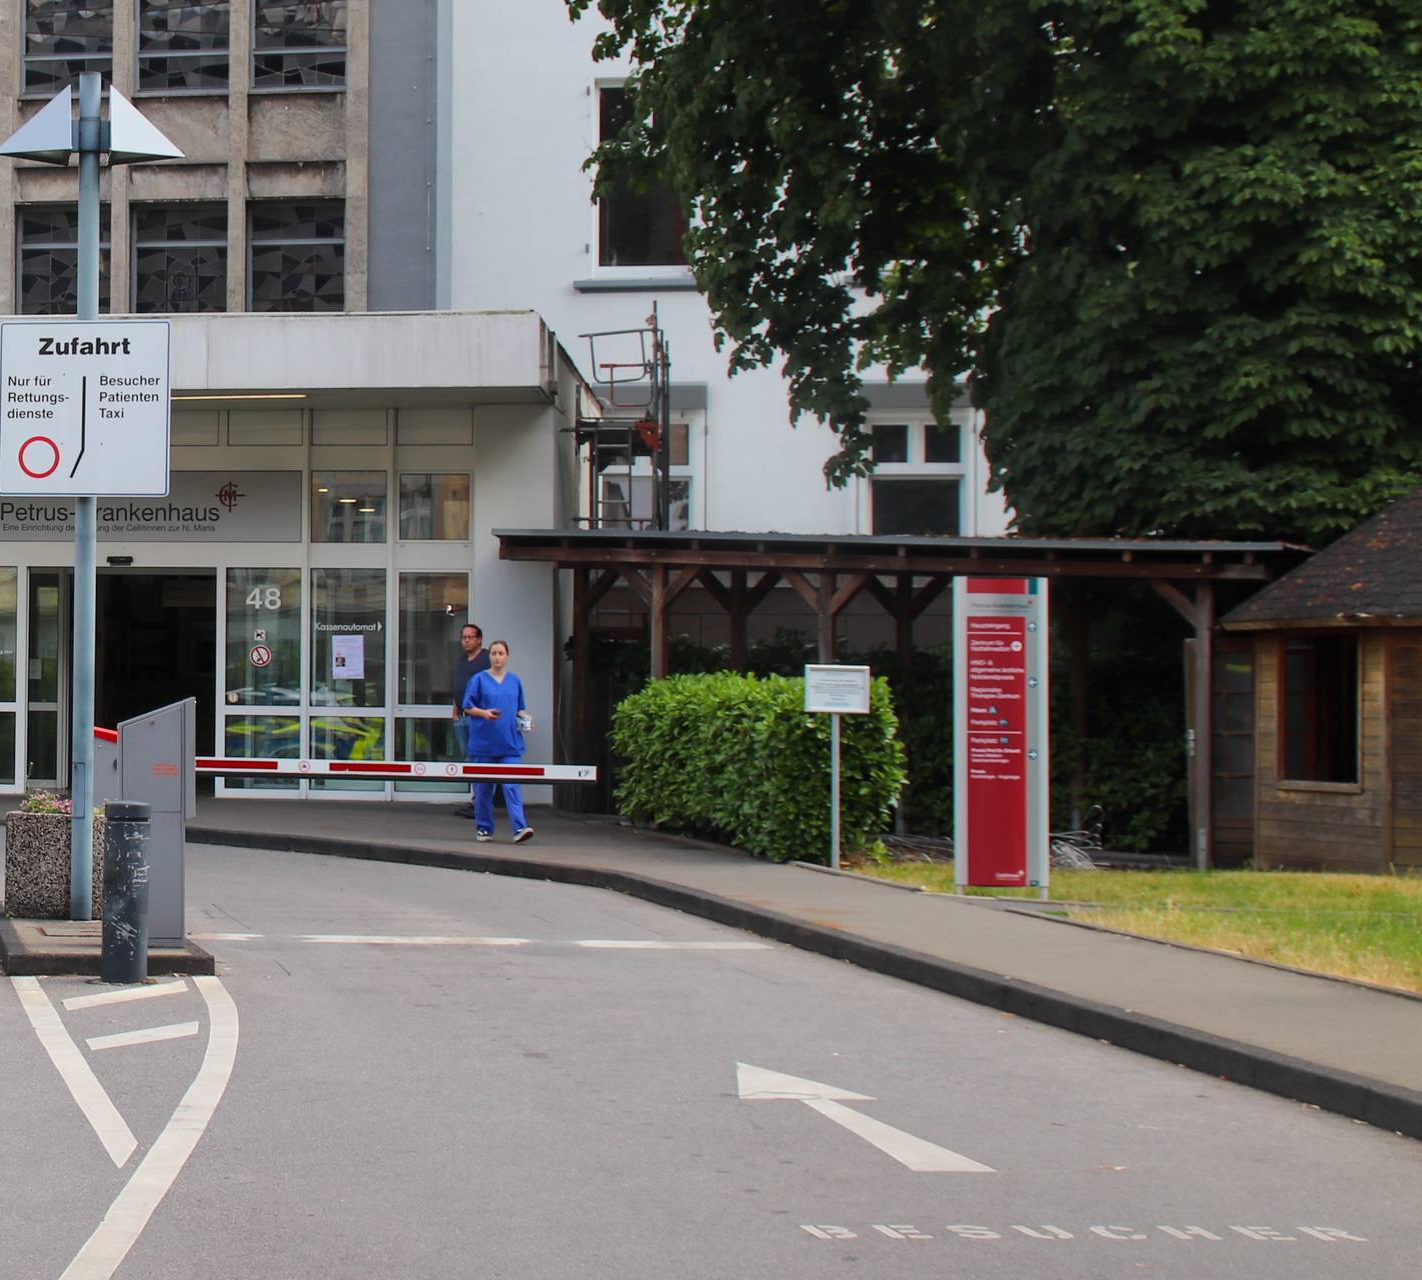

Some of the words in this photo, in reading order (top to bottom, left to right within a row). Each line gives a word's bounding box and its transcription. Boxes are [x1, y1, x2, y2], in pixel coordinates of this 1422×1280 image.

[38, 337, 131, 356] Zufahrt
[8, 376, 30, 387] Nur
[34, 376, 52, 387] für
[100, 376, 160, 386] Besucher
[8, 392, 70, 405] Rettungs-
[100, 392, 159, 402] Patienten
[7, 409, 54, 419] dienste
[100, 408, 124, 418] Taxi
[0, 502, 220, 522] Petrus-rankenhaus
[245, 587, 282, 610] 48
[314, 622, 377, 631] Kassenautomat
[800, 1223, 1369, 1243] BESUCHER
